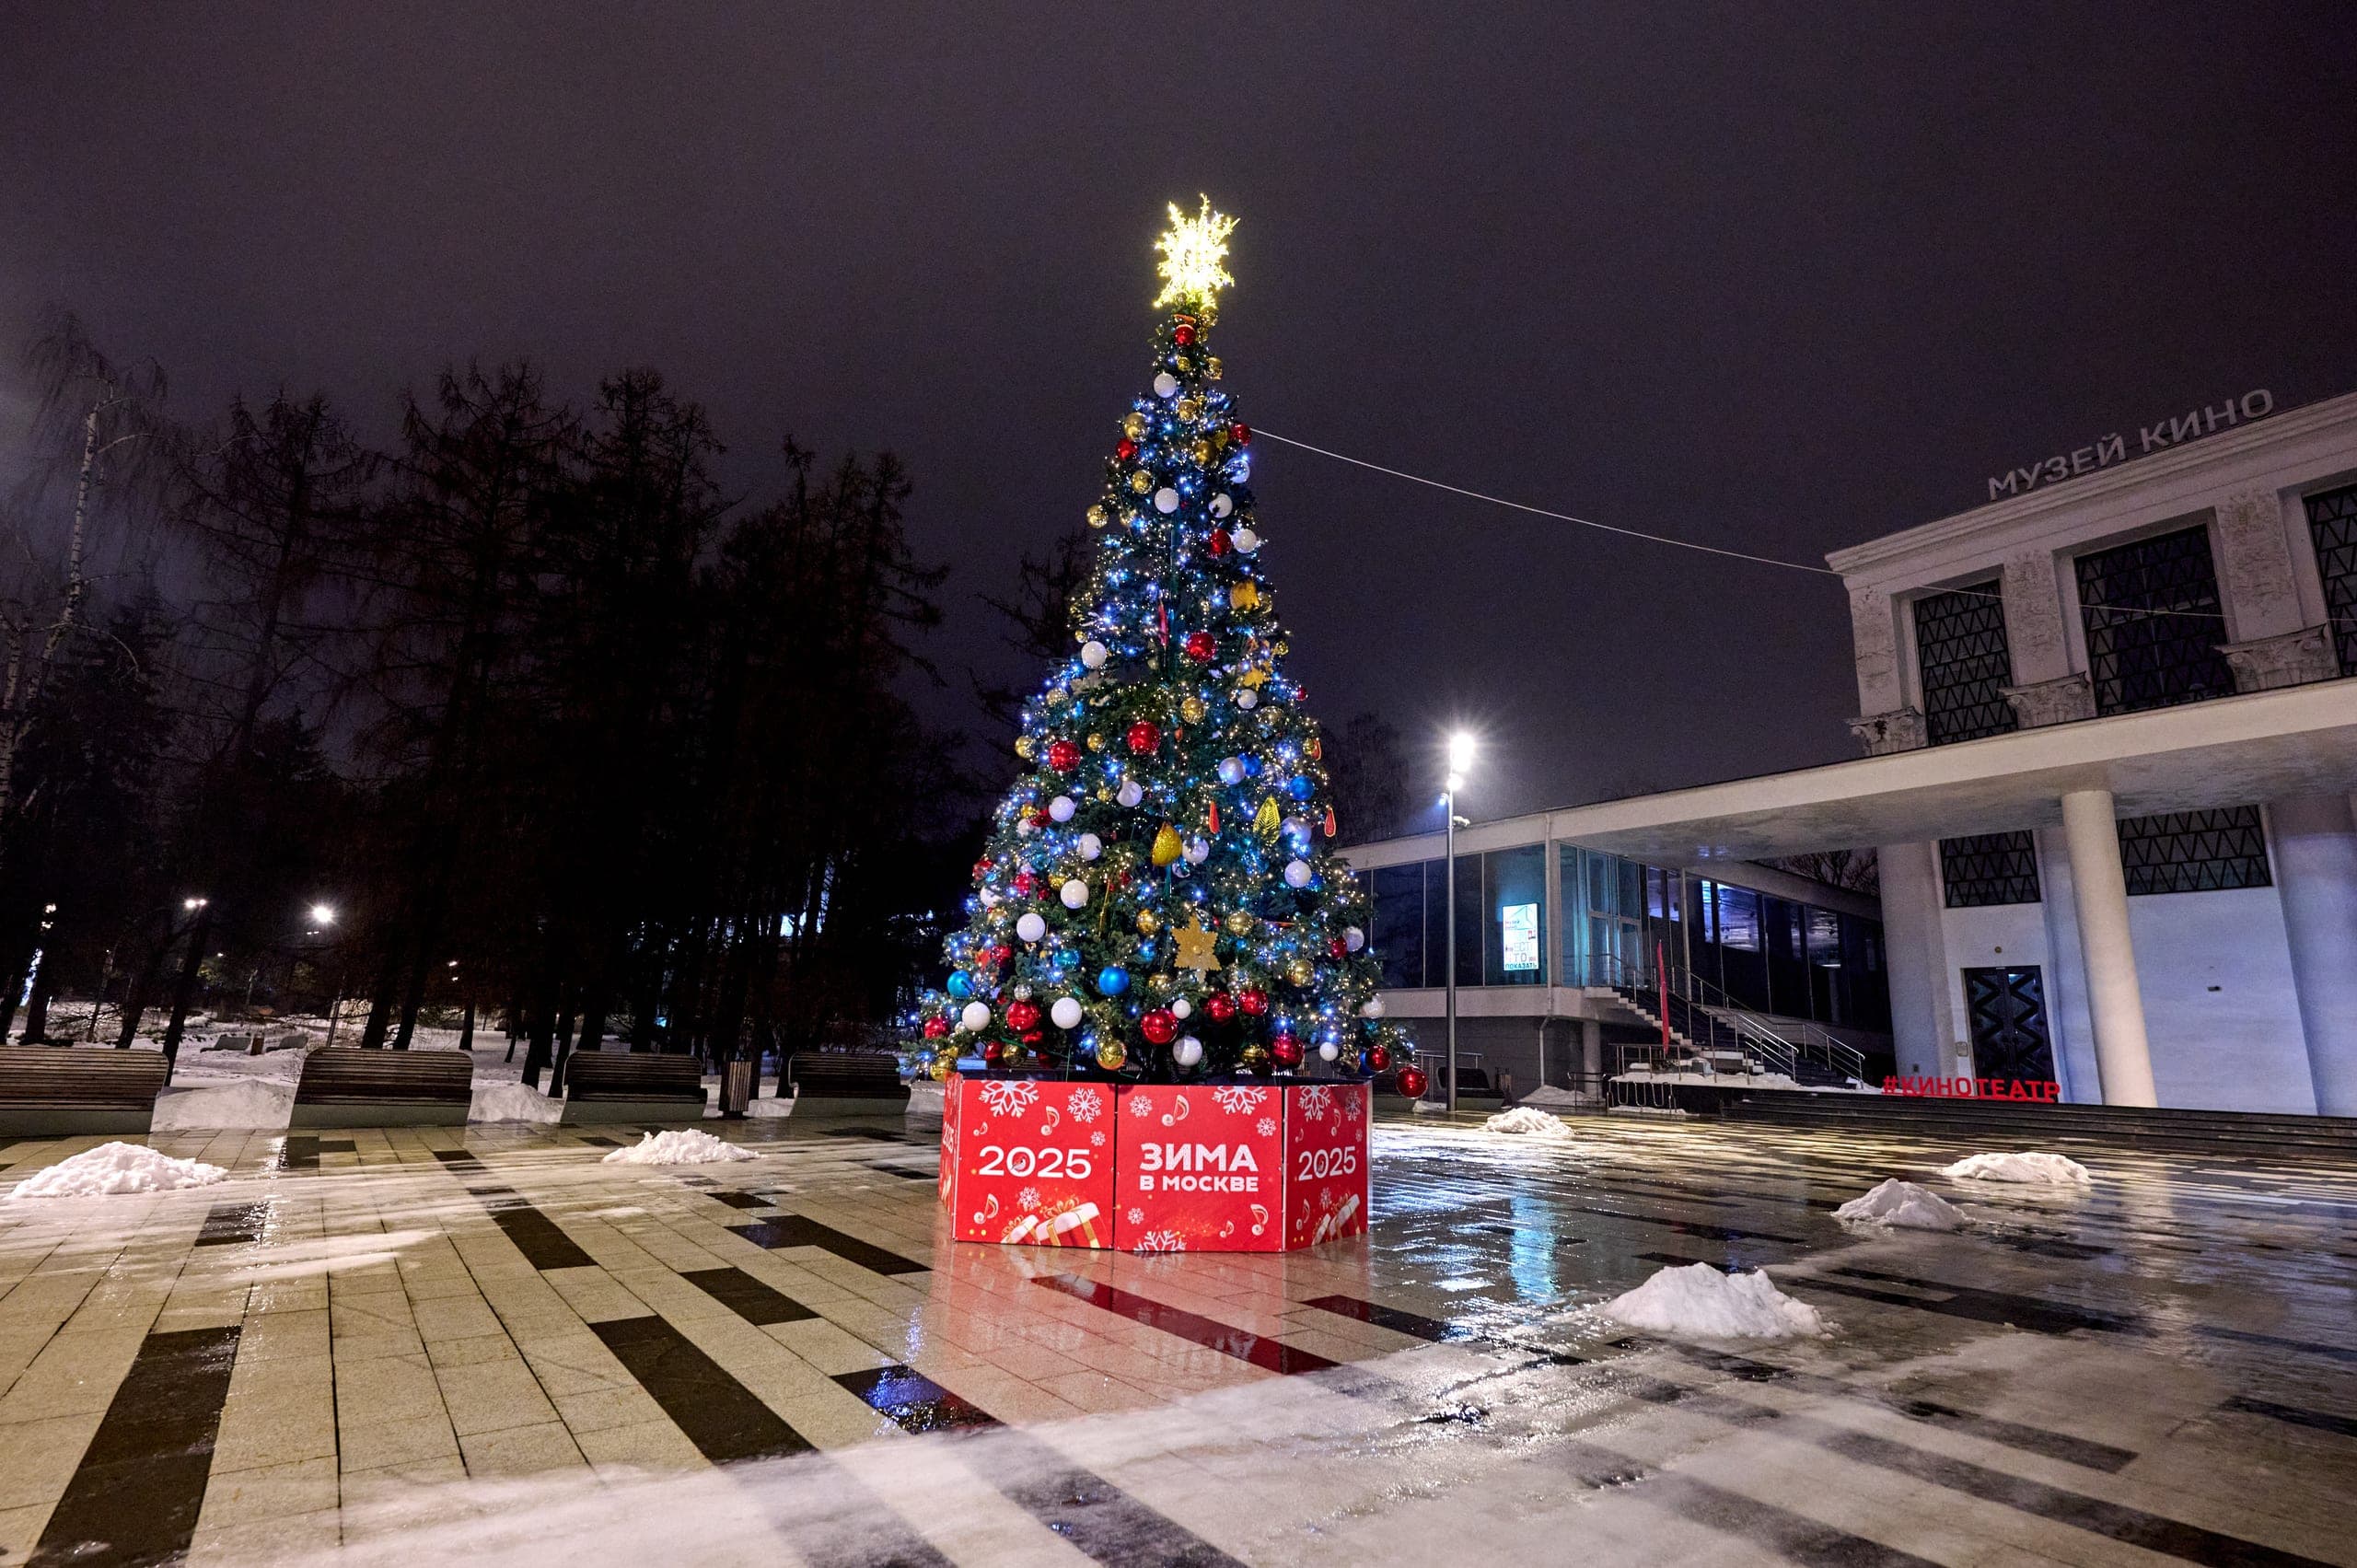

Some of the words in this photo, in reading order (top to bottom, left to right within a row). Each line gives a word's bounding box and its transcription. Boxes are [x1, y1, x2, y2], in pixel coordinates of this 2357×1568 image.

[1989, 433, 2127, 501] МУЗЕЙ
[2141, 389, 2274, 453] КИНО
[1882, 1075, 2060, 1103] #КИНОТЕАТР
[979, 1144, 1092, 1179] 2025
[1140, 1143, 1259, 1173] ЗИМА
[1298, 1145, 1357, 1181] 2025
[1140, 1175, 1155, 1192] В
[1163, 1175, 1259, 1193] МОСКВЕ
